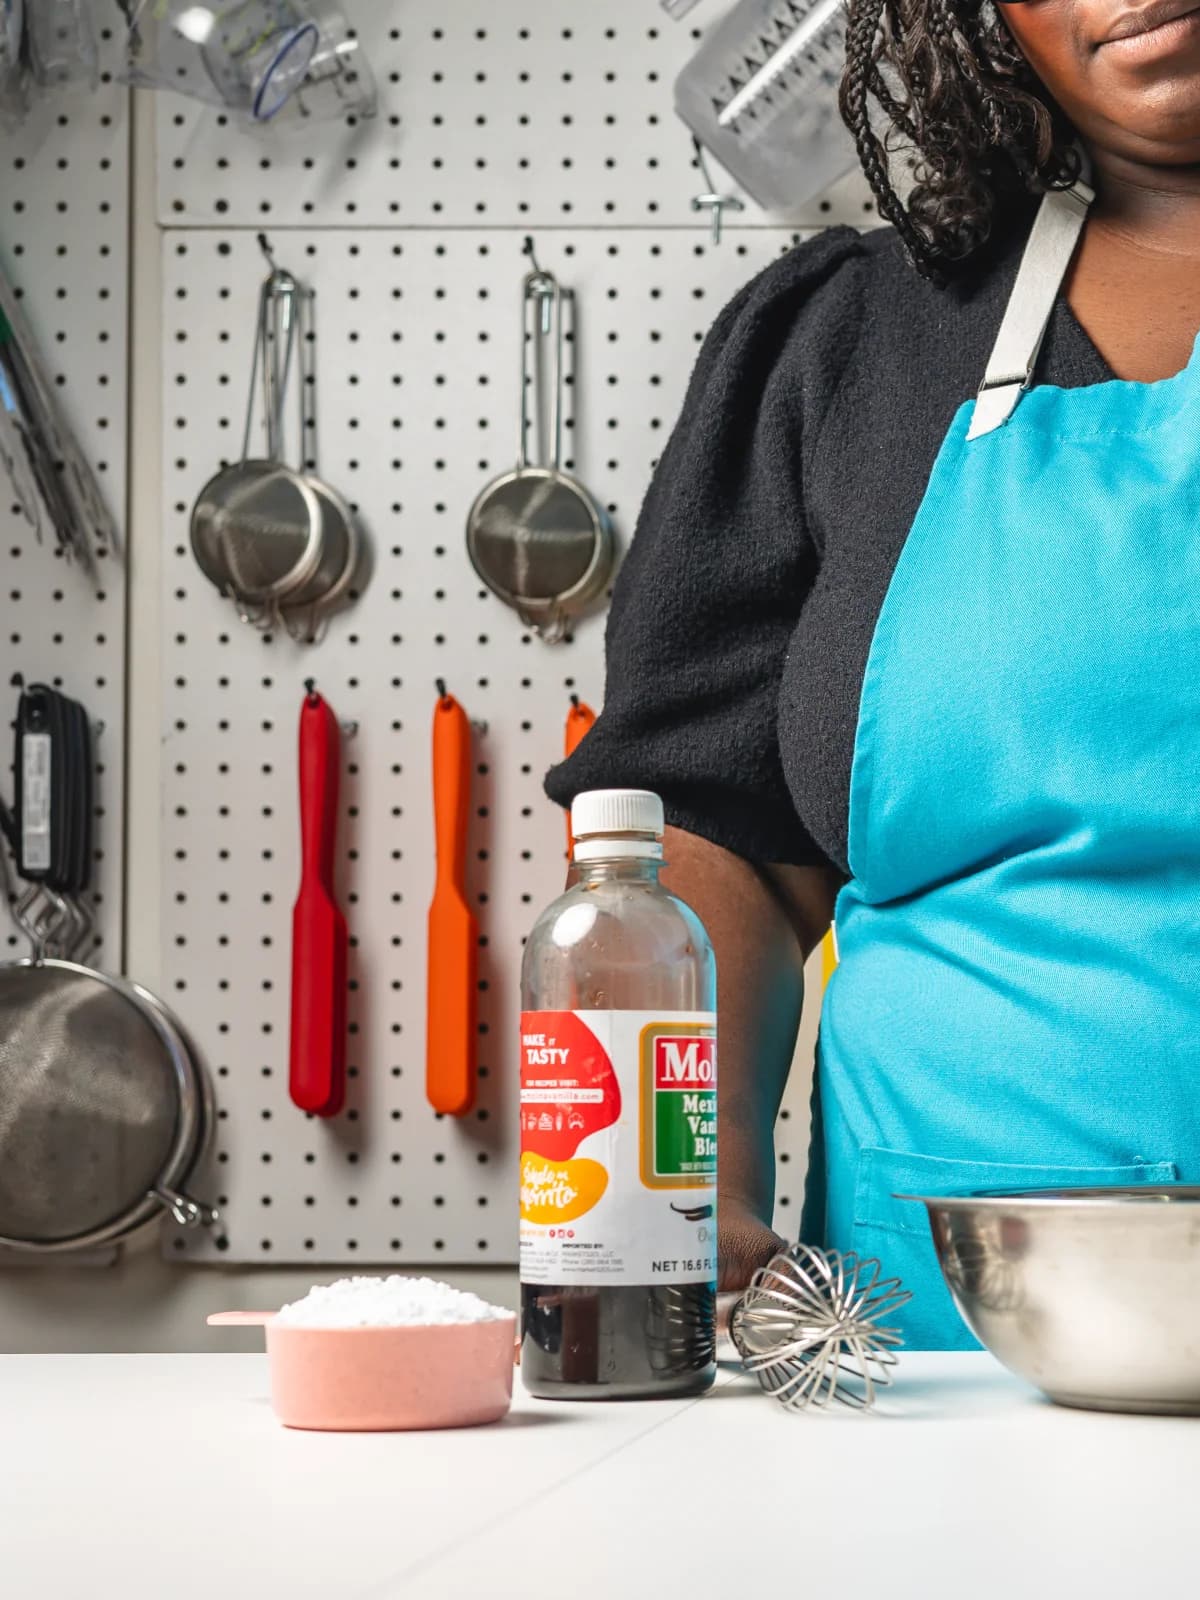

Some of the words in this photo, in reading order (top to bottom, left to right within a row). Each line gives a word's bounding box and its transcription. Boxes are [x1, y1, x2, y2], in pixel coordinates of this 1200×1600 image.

[522, 1034, 546, 1046] MAKE
[526, 1048, 570, 1065] TASTY
[652, 1261, 679, 1272] NET
[682, 1259, 702, 1271] 16.6
